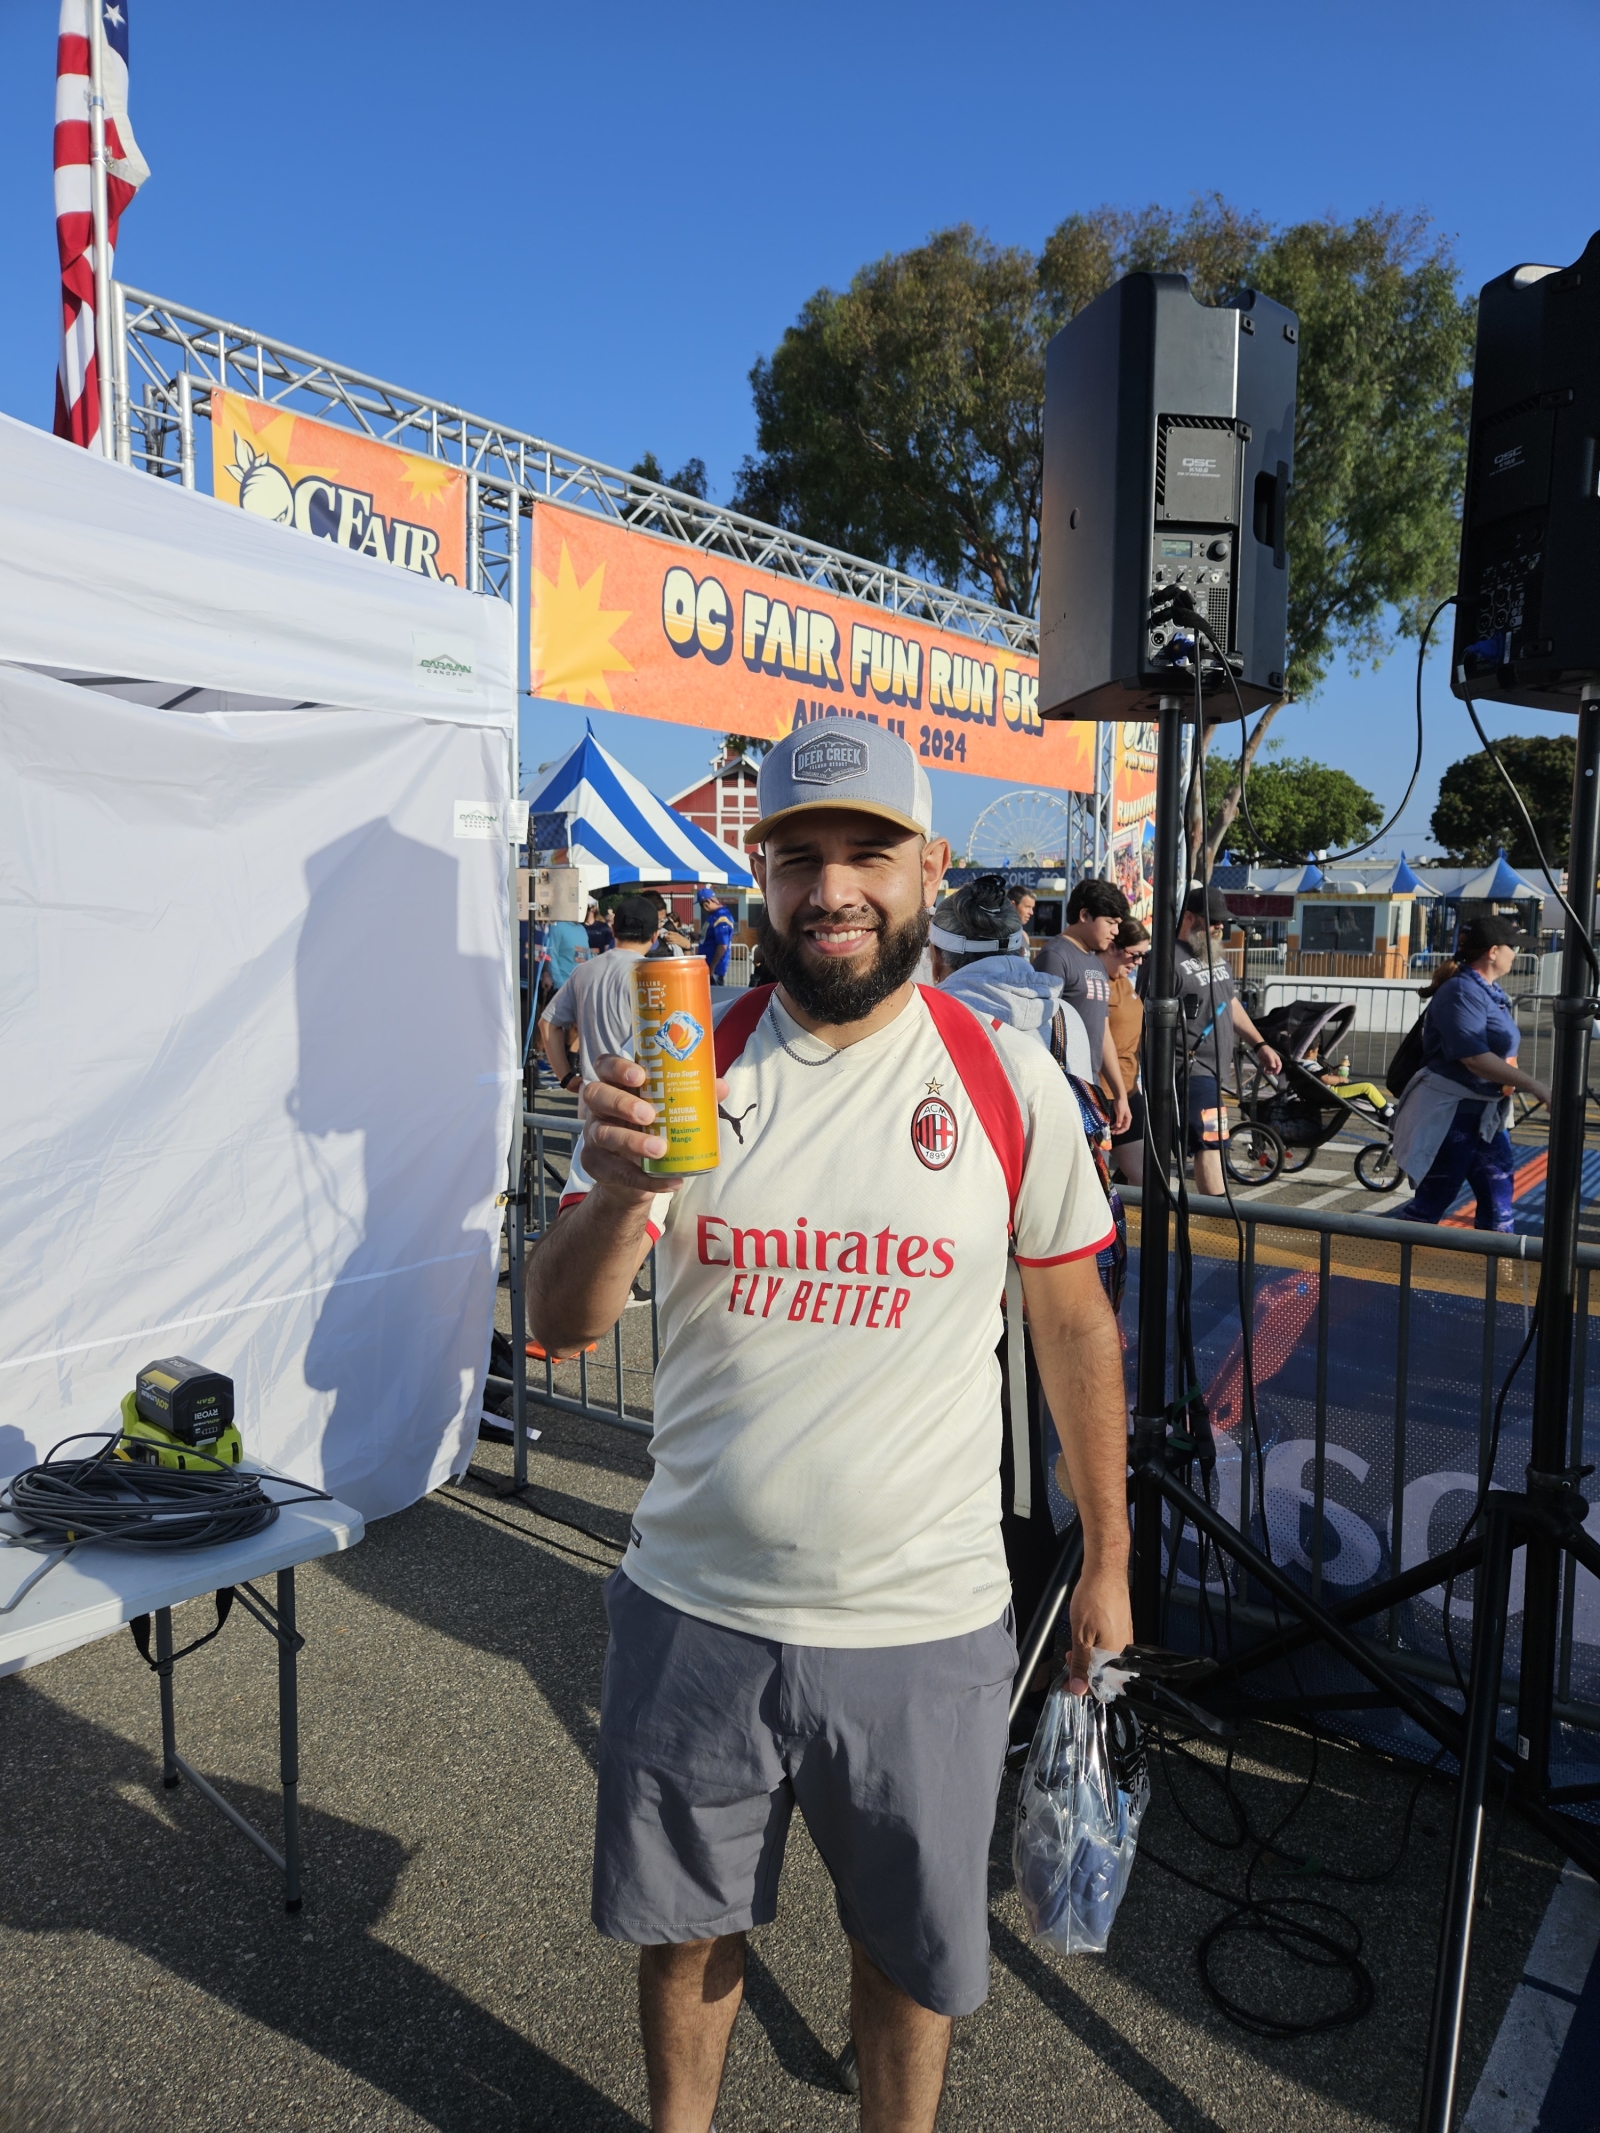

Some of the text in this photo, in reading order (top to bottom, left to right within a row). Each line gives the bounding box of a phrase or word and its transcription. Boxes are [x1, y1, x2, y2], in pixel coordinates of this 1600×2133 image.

[1493, 445, 1523, 465] QSC
[1182, 457, 1217, 468] QSC
[662, 566, 1045, 737] OC FAIR FUN RUN 5K
[426, 668, 463, 677] CANOPY
[920, 725, 966, 763] 2024
[797, 749, 824, 772] DEER
[826, 747, 861, 766] CREEK
[635, 987, 661, 1008] CE
[681, 1069, 700, 1078] Sugar
[668, 1106, 697, 1115] NATURAL
[922, 1104, 948, 1116] ACM
[669, 1114, 698, 1123] CAFFEINE
[670, 1126, 701, 1134] Maximum
[925, 1151, 946, 1160] 1899
[696, 1214, 956, 1279] Emirates
[728, 1274, 912, 1329] FLY BETTER
[194, 1408, 219, 1421] RYOBI
